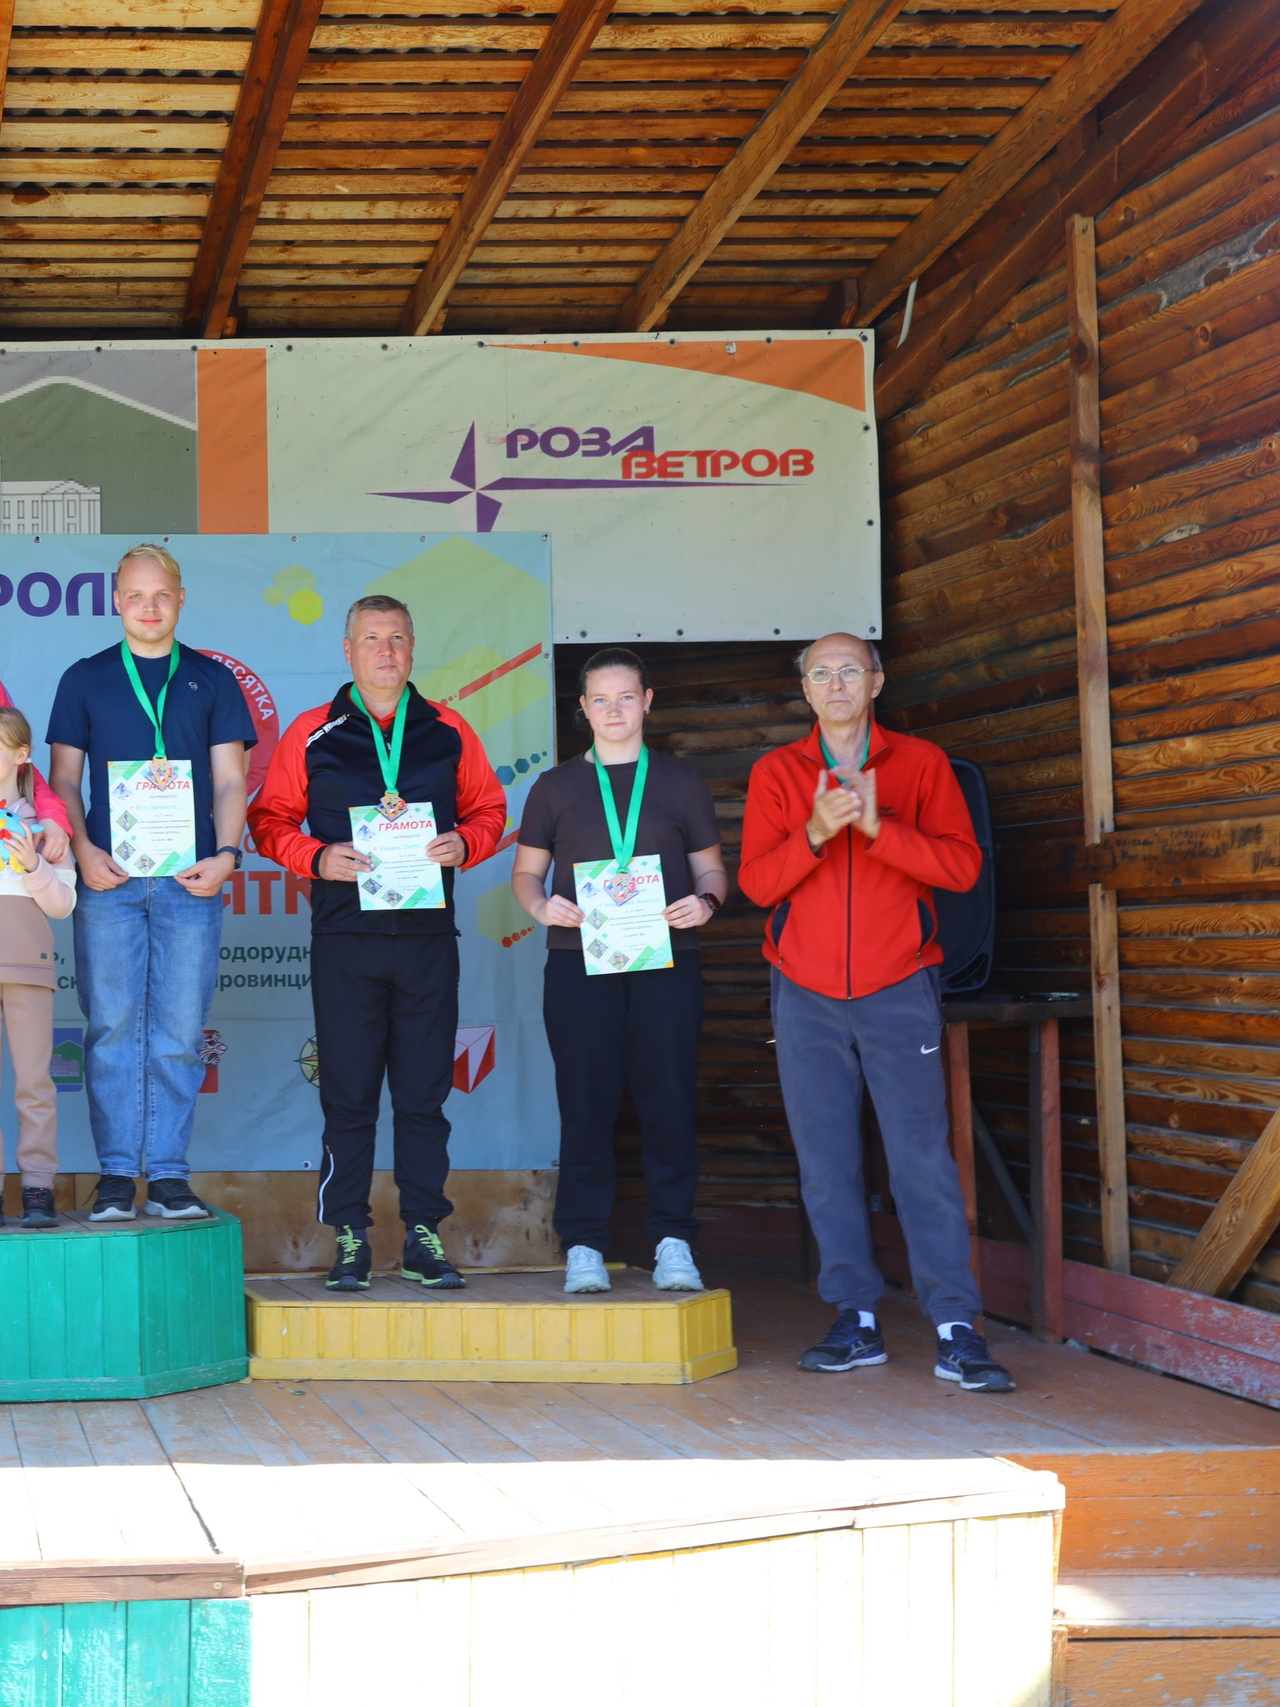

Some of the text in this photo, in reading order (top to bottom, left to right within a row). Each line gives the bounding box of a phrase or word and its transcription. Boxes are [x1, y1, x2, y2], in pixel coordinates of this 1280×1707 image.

[506, 426, 655, 458] РОЗА
[622, 449, 815, 479] ВЕТРОВ
[135, 781, 191, 791] ГРАОТА
[397, 800, 406, 809] 3
[378, 820, 433, 832] ГРАМОТА
[628, 882, 636, 892] 3
